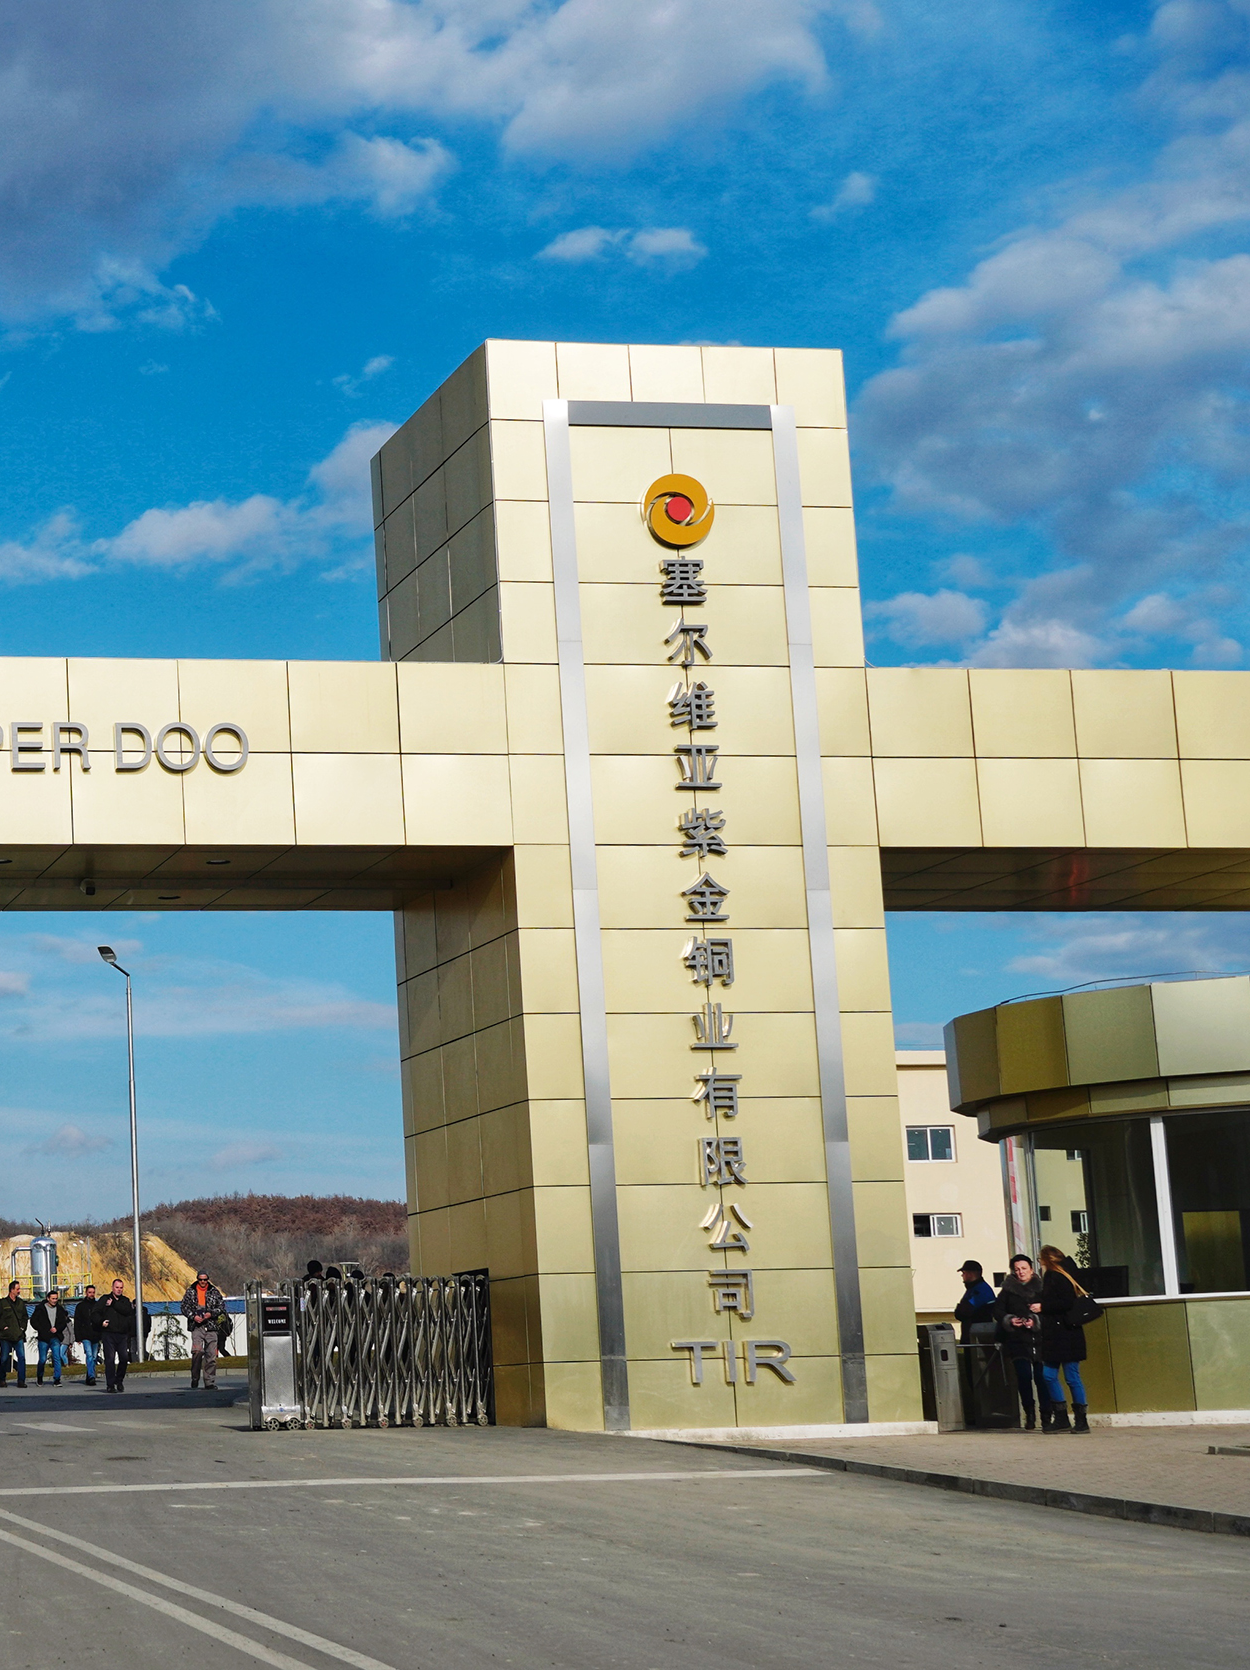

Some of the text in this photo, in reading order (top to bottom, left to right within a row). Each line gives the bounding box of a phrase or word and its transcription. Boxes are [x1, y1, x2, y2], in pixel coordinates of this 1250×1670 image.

[114, 721, 249, 772] DOO
[659, 556, 753, 1318] 塞尔维亚紫金铜业有限公司
[671, 1339, 797, 1385] TIR
